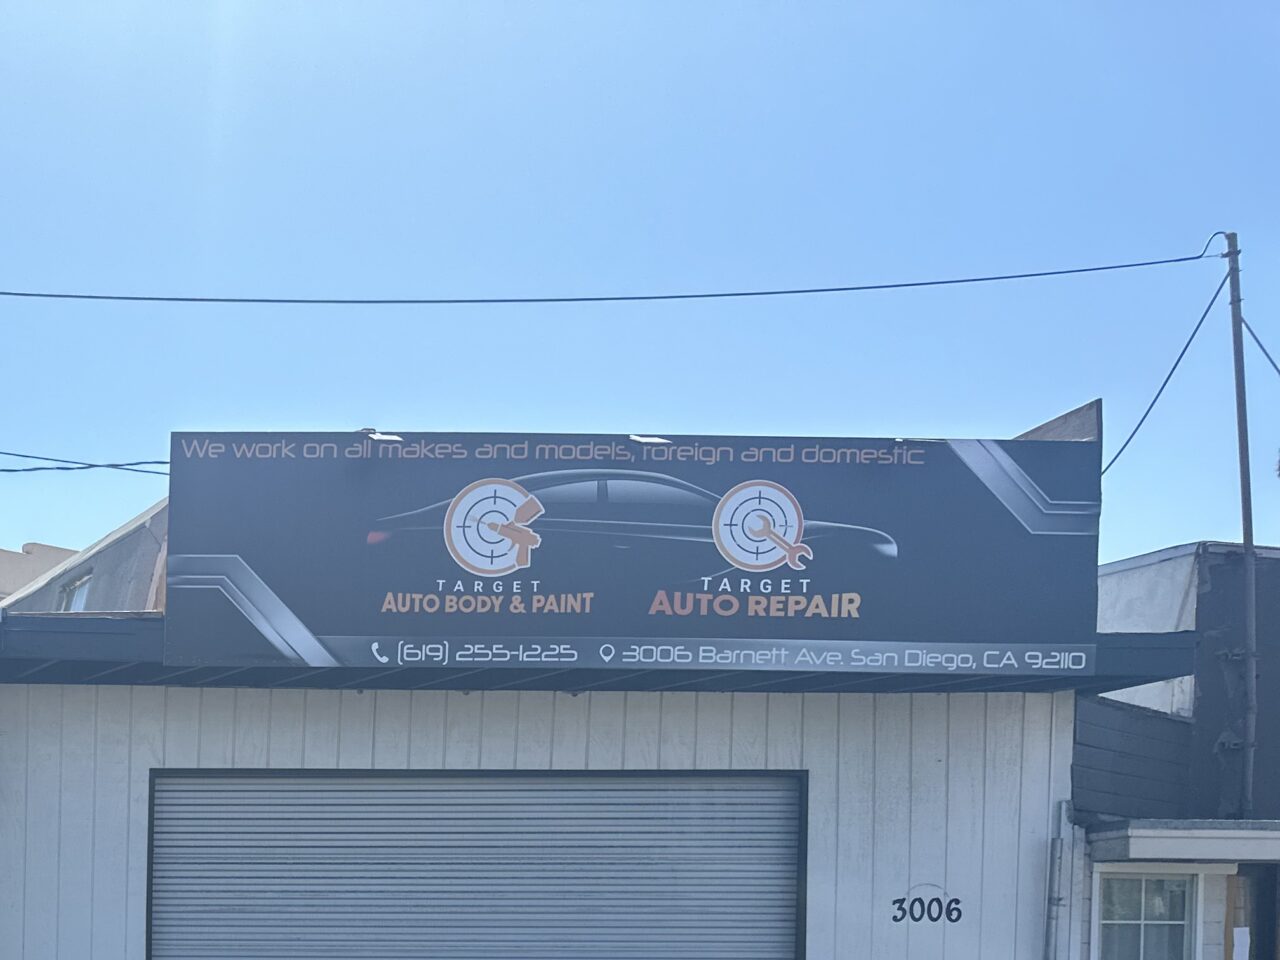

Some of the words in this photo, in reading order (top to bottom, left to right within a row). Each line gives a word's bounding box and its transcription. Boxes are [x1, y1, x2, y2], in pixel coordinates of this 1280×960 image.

[181, 439, 225, 459] We
[232, 440, 296, 459] work
[303, 443, 338, 459] on
[344, 439, 372, 459] all
[378, 440, 467, 459] makes
[475, 441, 528, 460] and
[535, 441, 635, 463] models,
[740, 444, 795, 463] and
[801, 444, 925, 465] domestic
[436, 580, 540, 592] TARGET
[701, 577, 811, 593] TARGET
[381, 592, 440, 613] AUTO
[444, 595, 504, 613] BODY
[509, 595, 527, 614] &
[531, 592, 595, 614] PAINT
[648, 590, 740, 616] AUTO
[747, 593, 862, 618] REPAIR
[397, 640, 449, 665] (619)
[455, 644, 578, 662] 255-1225
[622, 645, 693, 663] 3006
[698, 646, 789, 664] Barnett
[794, 647, 844, 666] Ave.
[850, 649, 898, 667] San
[904, 650, 976, 671] Diego,
[983, 651, 1019, 669] CA
[1024, 651, 1087, 670] 92110
[891, 897, 963, 923] 3006
